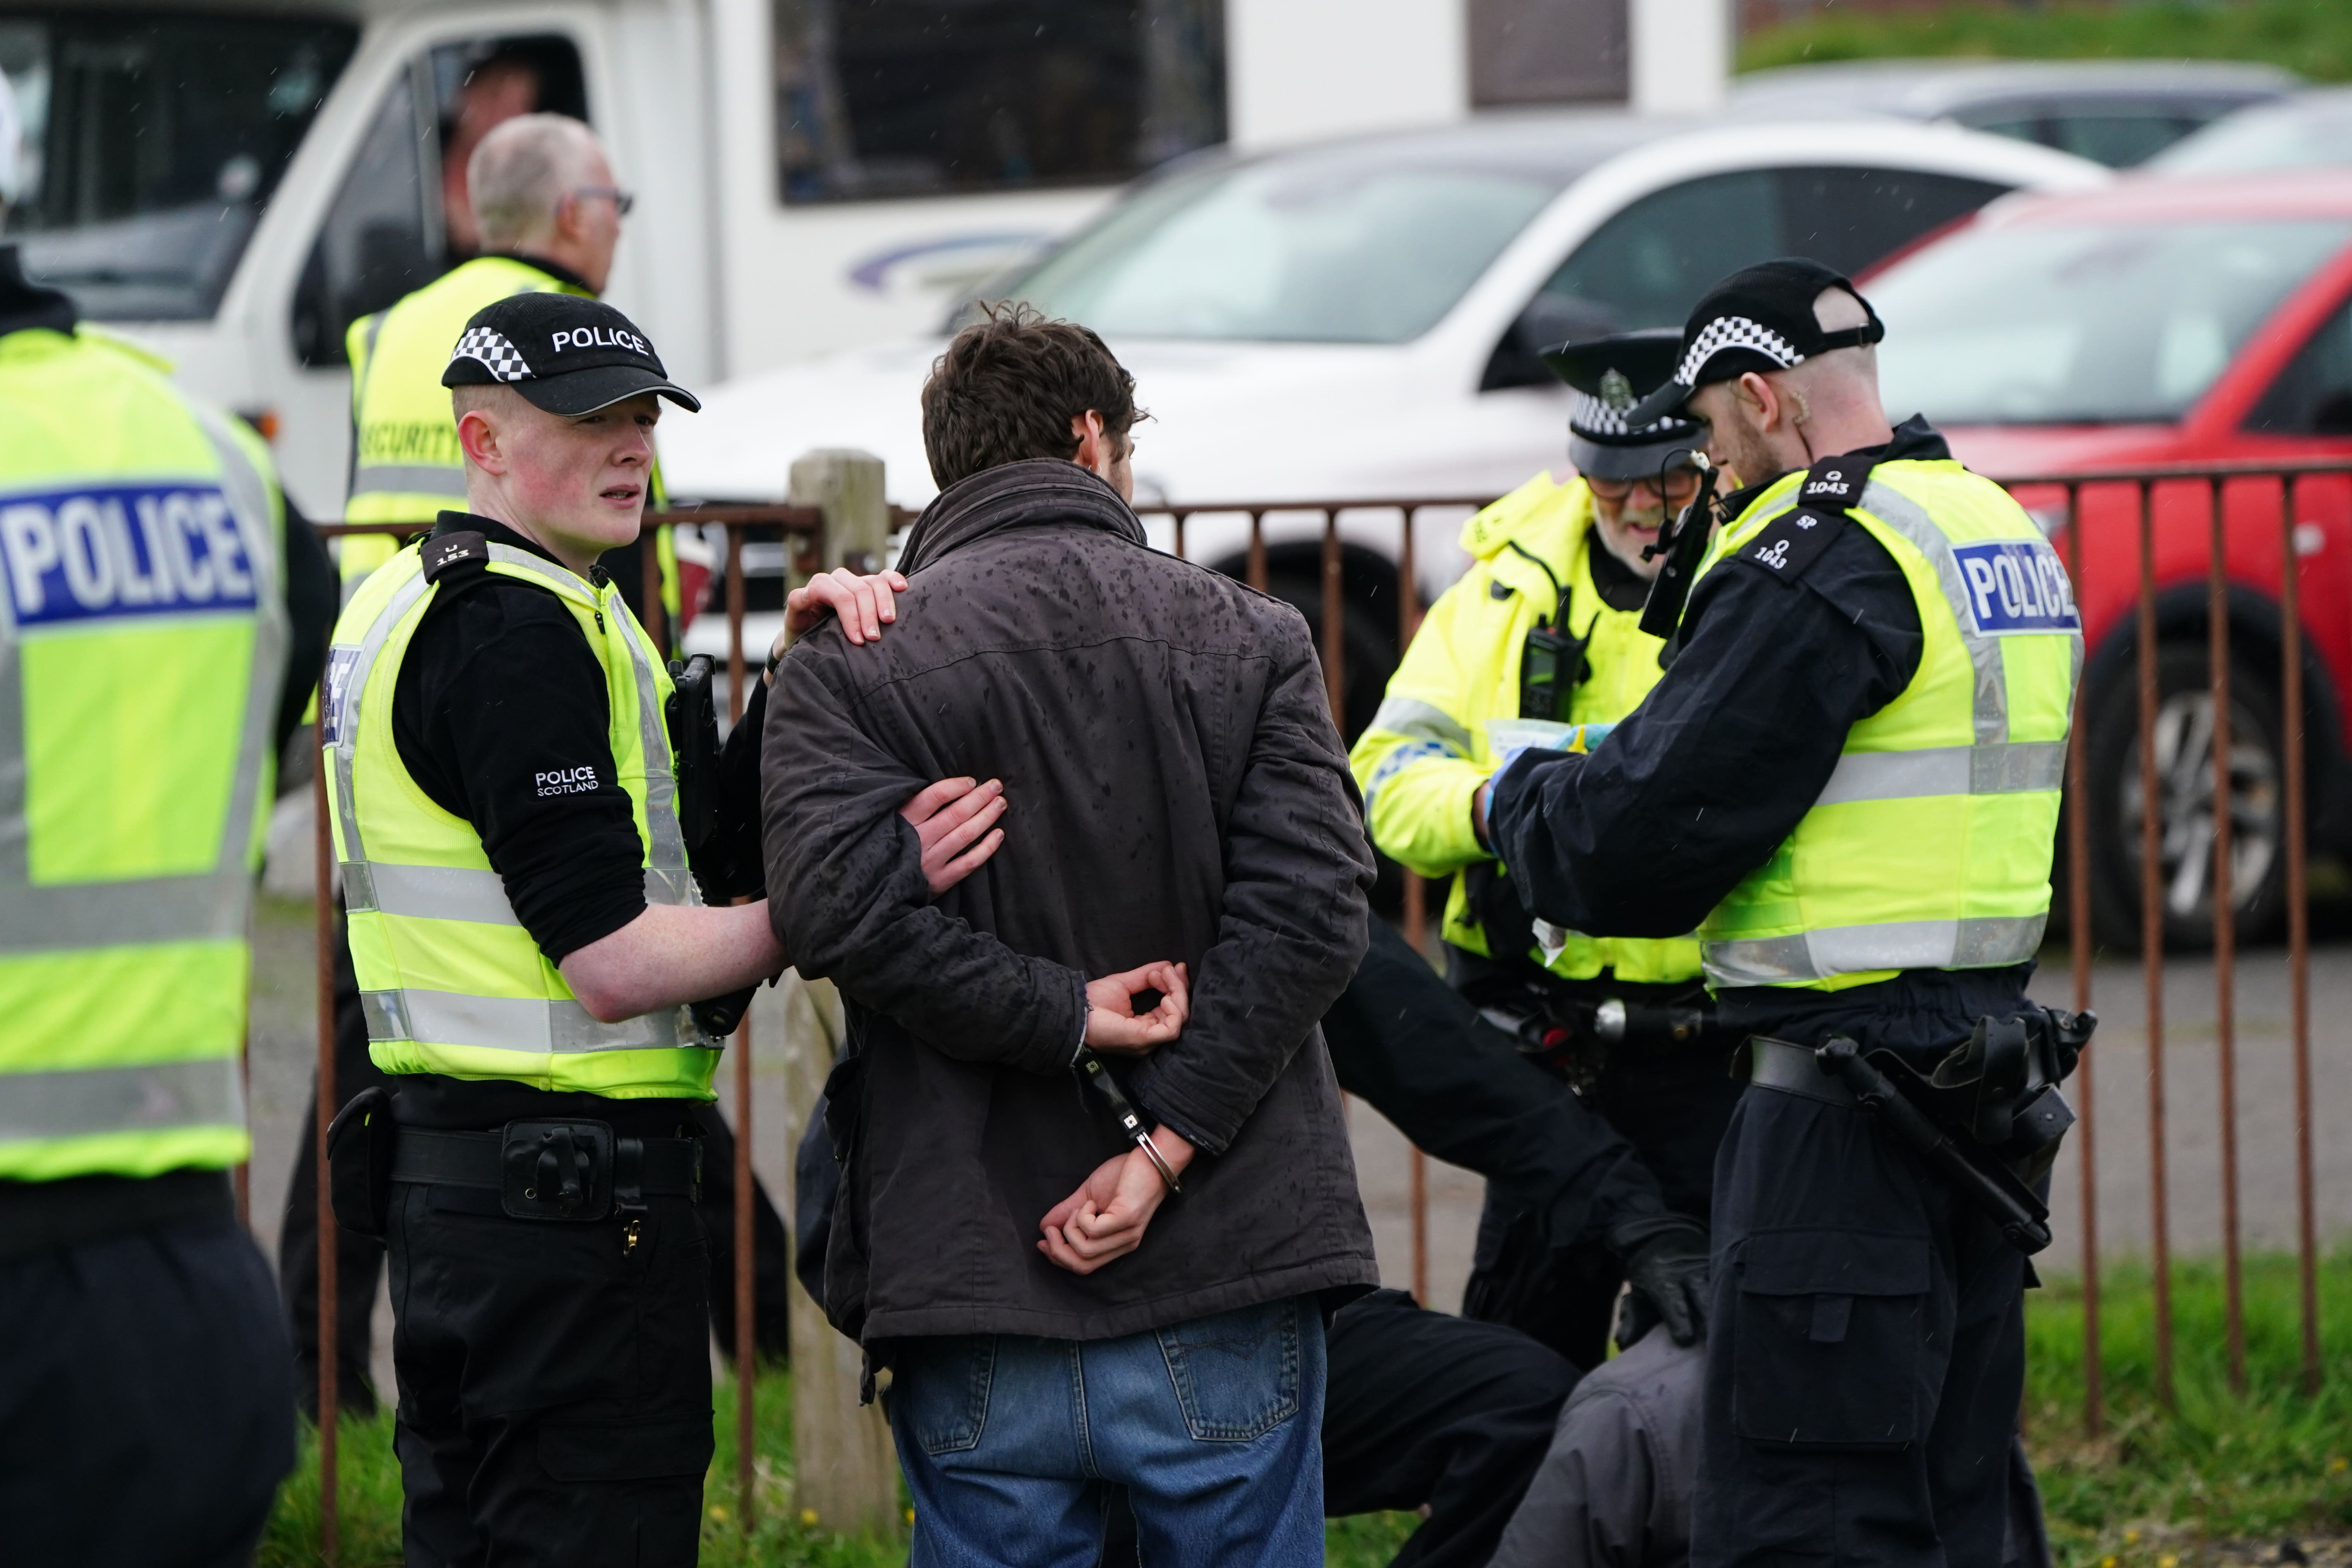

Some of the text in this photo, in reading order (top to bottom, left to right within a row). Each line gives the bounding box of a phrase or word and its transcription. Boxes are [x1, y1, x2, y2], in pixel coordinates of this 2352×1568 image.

[552, 327, 649, 356] POLICE
[1805, 481, 1850, 495] 1043
[1, 495, 253, 614] POLICE
[437, 549, 469, 566] 153
[1754, 547, 1787, 569] 1043
[1963, 554, 2075, 619] POLICE
[535, 766, 595, 787] POLICE
[537, 780, 599, 796] SCOTLAND
